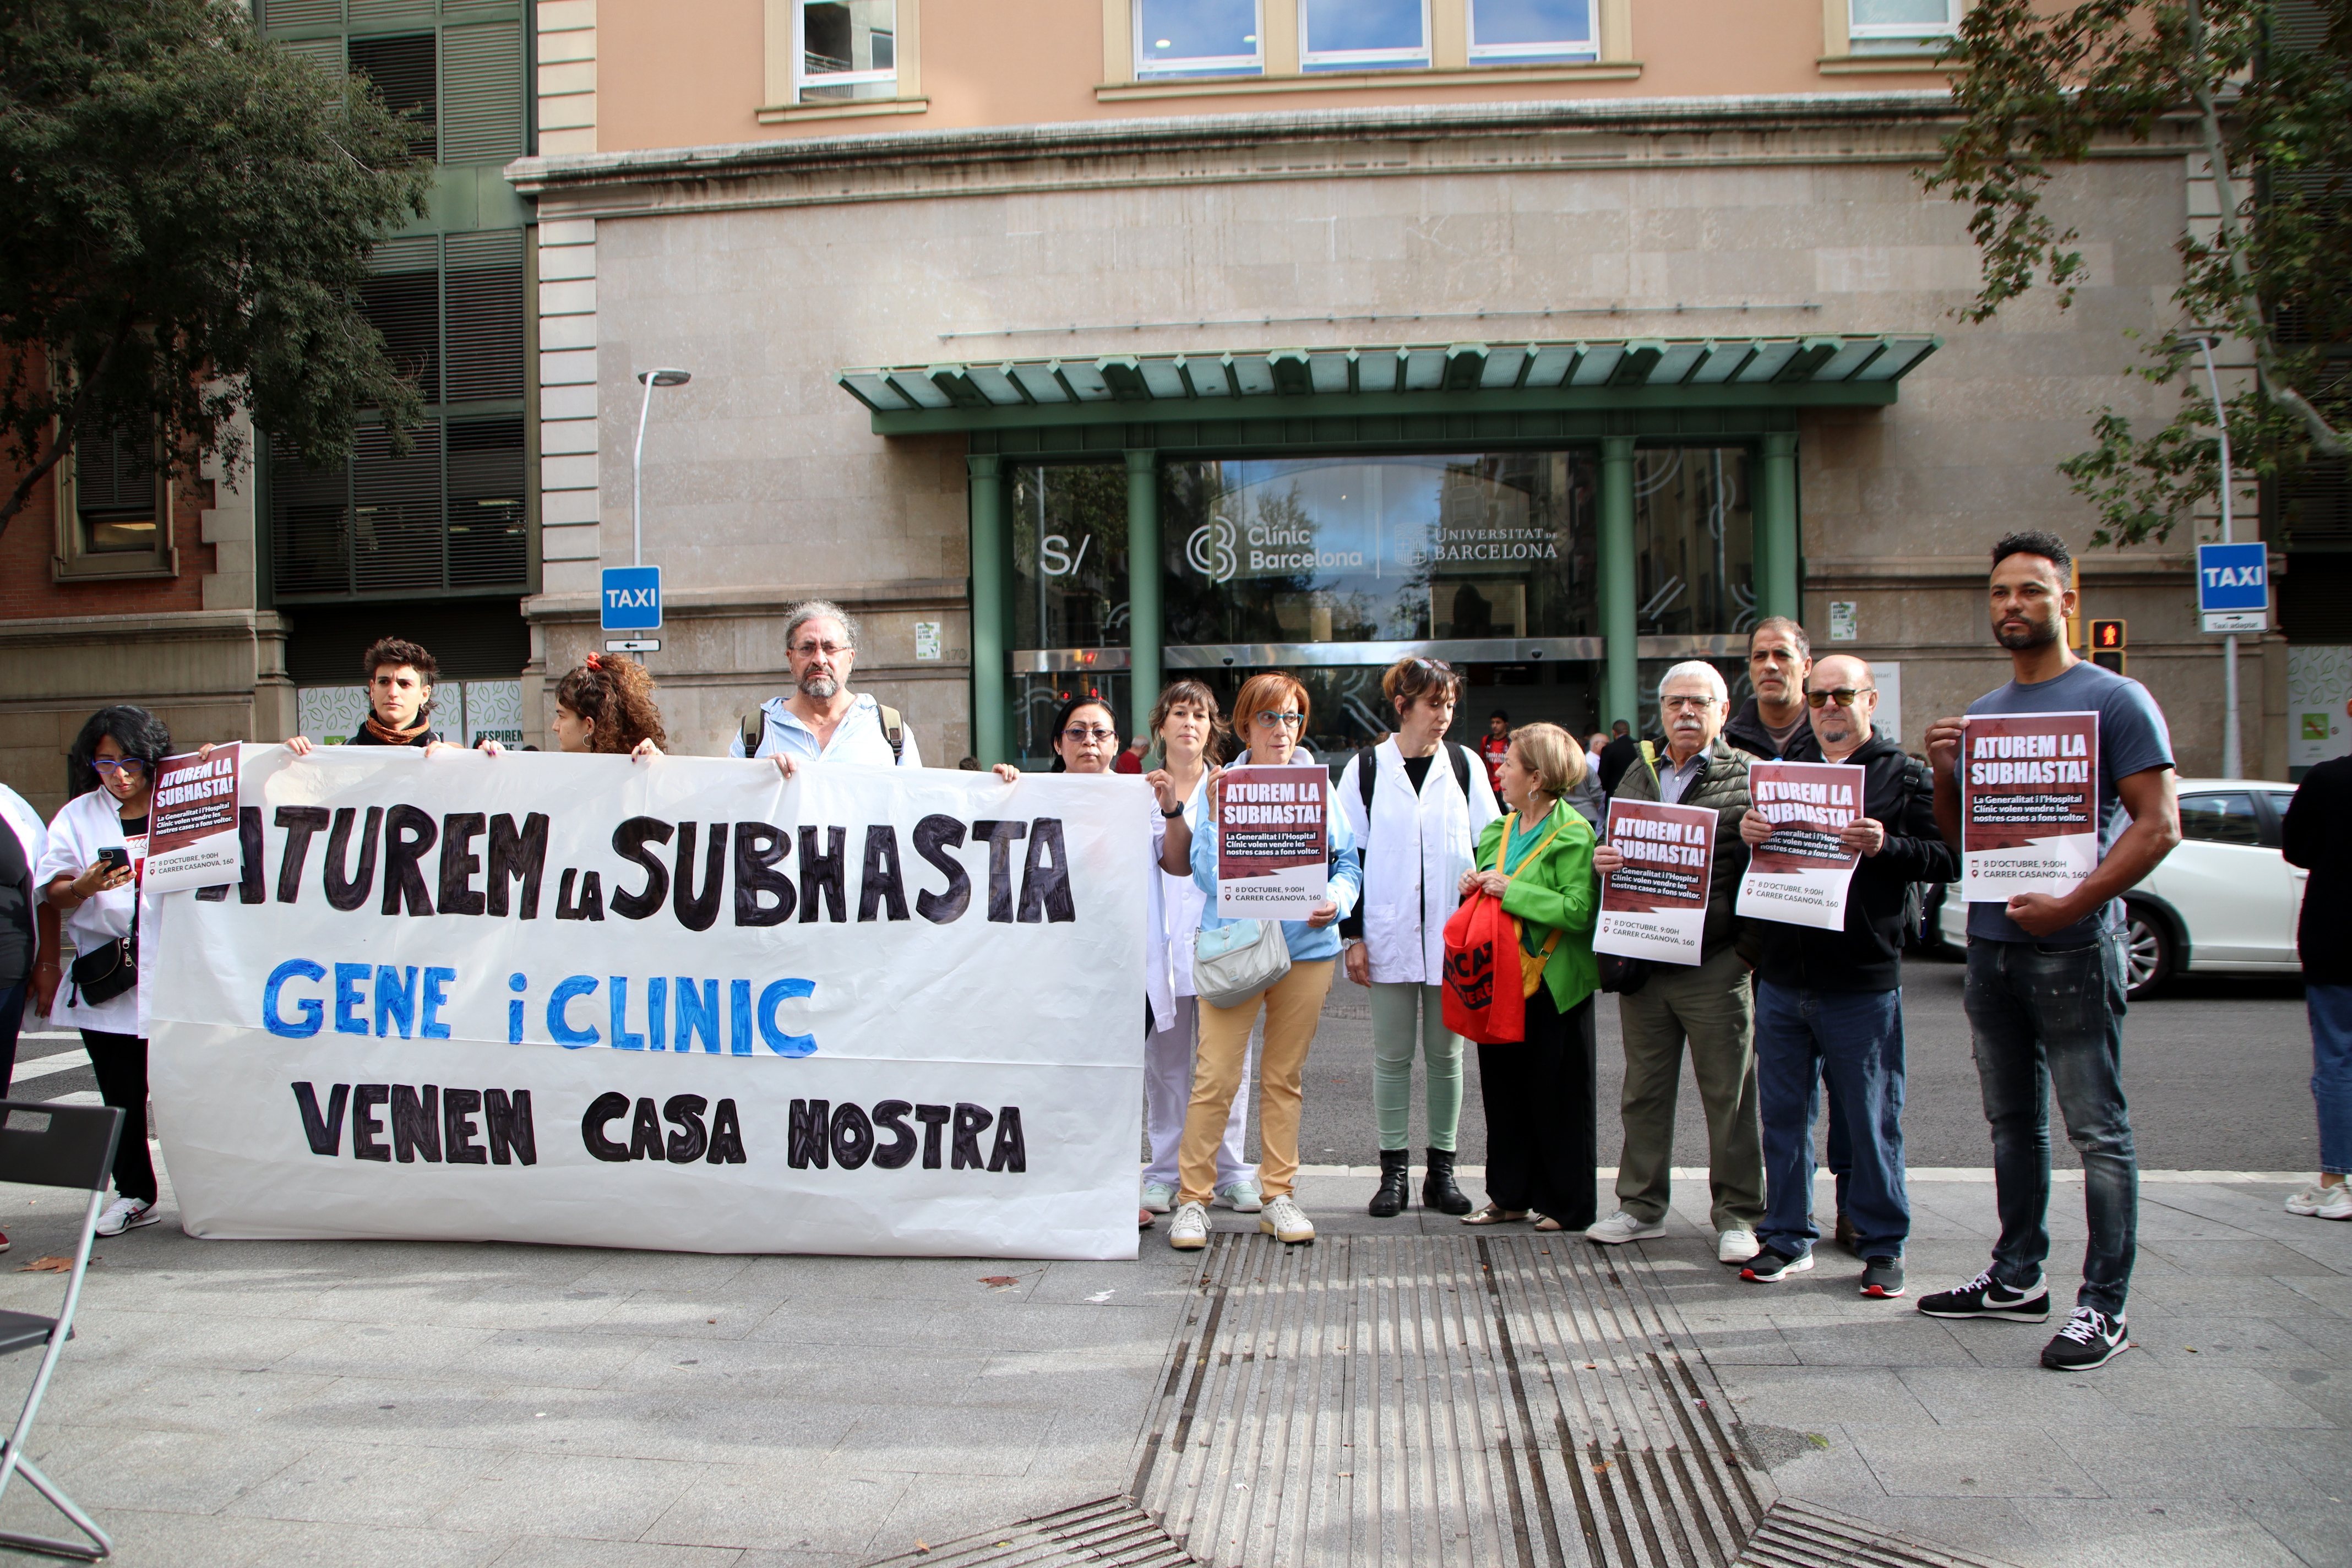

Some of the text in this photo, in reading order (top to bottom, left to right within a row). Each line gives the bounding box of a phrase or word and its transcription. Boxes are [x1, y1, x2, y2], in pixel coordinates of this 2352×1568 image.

[1248, 525, 1310, 546] Clínic
[1250, 548, 1363, 569] Barcelona
[1435, 543, 1558, 559] BARCELONA
[2203, 566, 2263, 587] TAXI
[606, 588, 656, 608] TAXI
[945, 649, 968, 660] 170
[1973, 734, 2087, 759] ATUREM LA
[159, 757, 233, 789] ATUREM LA
[1972, 760, 2088, 785] SUBHASTA!
[156, 776, 234, 808] SUBHASTA!
[1226, 783, 1320, 802] ATUREM LA
[1757, 781, 1853, 806] ATUREM LA
[1974, 796, 1984, 804] La
[1985, 795, 2034, 804] Generalitat
[2035, 795, 2038, 803] i
[165, 809, 198, 820] Generalitat
[1224, 805, 1321, 824] SUBHASTA!
[2024, 804, 2055, 813] vendre
[174, 816, 190, 825] volen
[191, 813, 211, 821] vendre
[2038, 814, 2057, 822] fons
[2059, 813, 2087, 821] voltor.
[156, 826, 178, 835] nostres
[1614, 817, 1705, 845] ATUREM LA
[1760, 845, 1787, 853] nostres
[1783, 839, 1803, 847] volen
[1804, 841, 1828, 850] vendre
[1612, 839, 1706, 867] SUBHASTA!
[556, 868, 605, 921] LA
[609, 814, 1076, 932] SUBHASTA
[1622, 867, 1661, 878] Generalitat
[1633, 876, 1652, 885] volen
[1653, 879, 1676, 888] vendre
[1663, 888, 1677, 896] fons
[1756, 890, 1783, 900] CARRER
[1804, 888, 1823, 896] 9:00H
[1613, 928, 1639, 938] CARRER
[1660, 927, 1679, 935] 9:00H
[263, 958, 457, 1039] GENE
[547, 974, 819, 1059] CLINIC
[291, 1082, 1026, 1173] VENEN CASA NOSTRA
